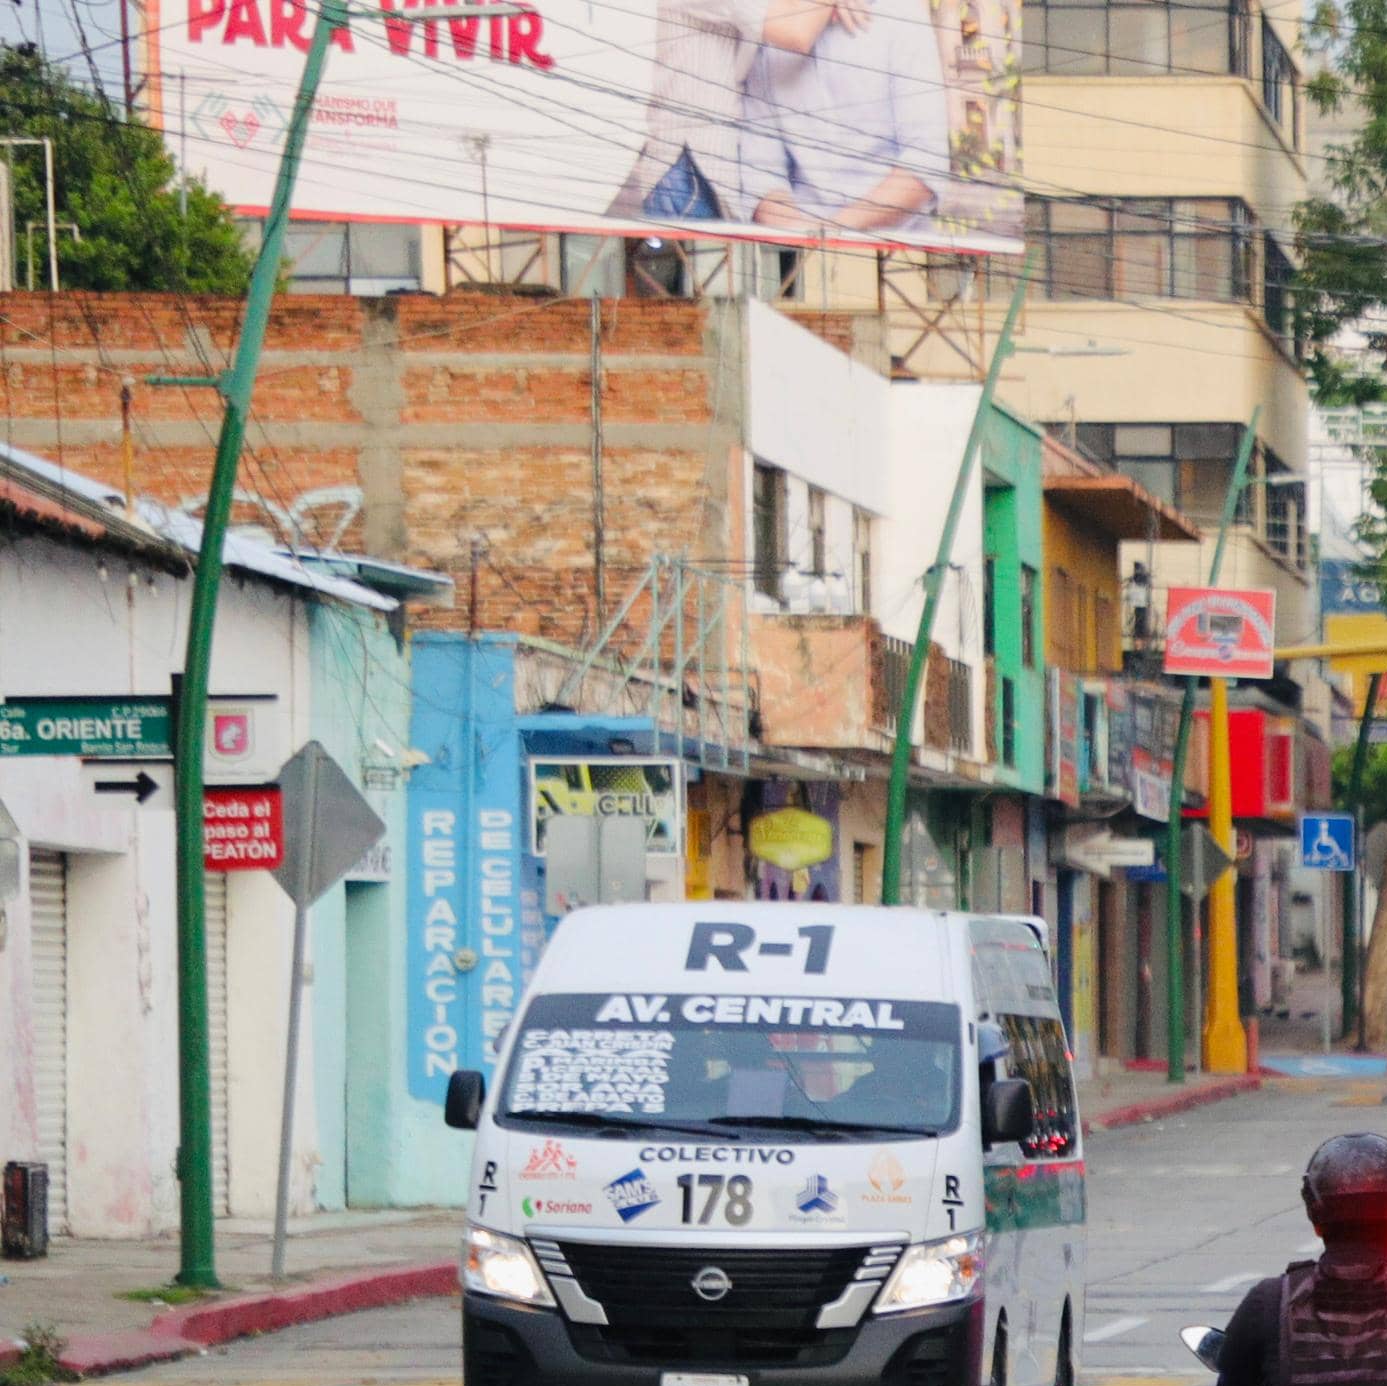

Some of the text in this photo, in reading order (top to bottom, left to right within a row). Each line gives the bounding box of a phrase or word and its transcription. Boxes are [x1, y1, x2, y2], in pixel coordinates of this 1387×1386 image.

[379, 0, 555, 70] VIVIR
[313, 96, 370, 111] MANISMO
[312, 110, 398, 128] ANSFORMA
[0, 718, 142, 741] 6a. ORIENTE
[203, 799, 272, 818] Ceda el
[204, 819, 271, 841] paso al
[478, 809, 513, 851] DE
[422, 808, 458, 1078] REPARACION
[684, 922, 836, 975] R-1
[595, 994, 905, 1031] AV. CENTRAL
[586, 1072, 671, 1084] MAYO
[591, 1082, 665, 1095] ANA
[638, 1145, 796, 1166] COLECTIVO
[483, 1160, 498, 1184] R
[946, 1174, 961, 1199] R
[675, 1172, 755, 1228] 178
